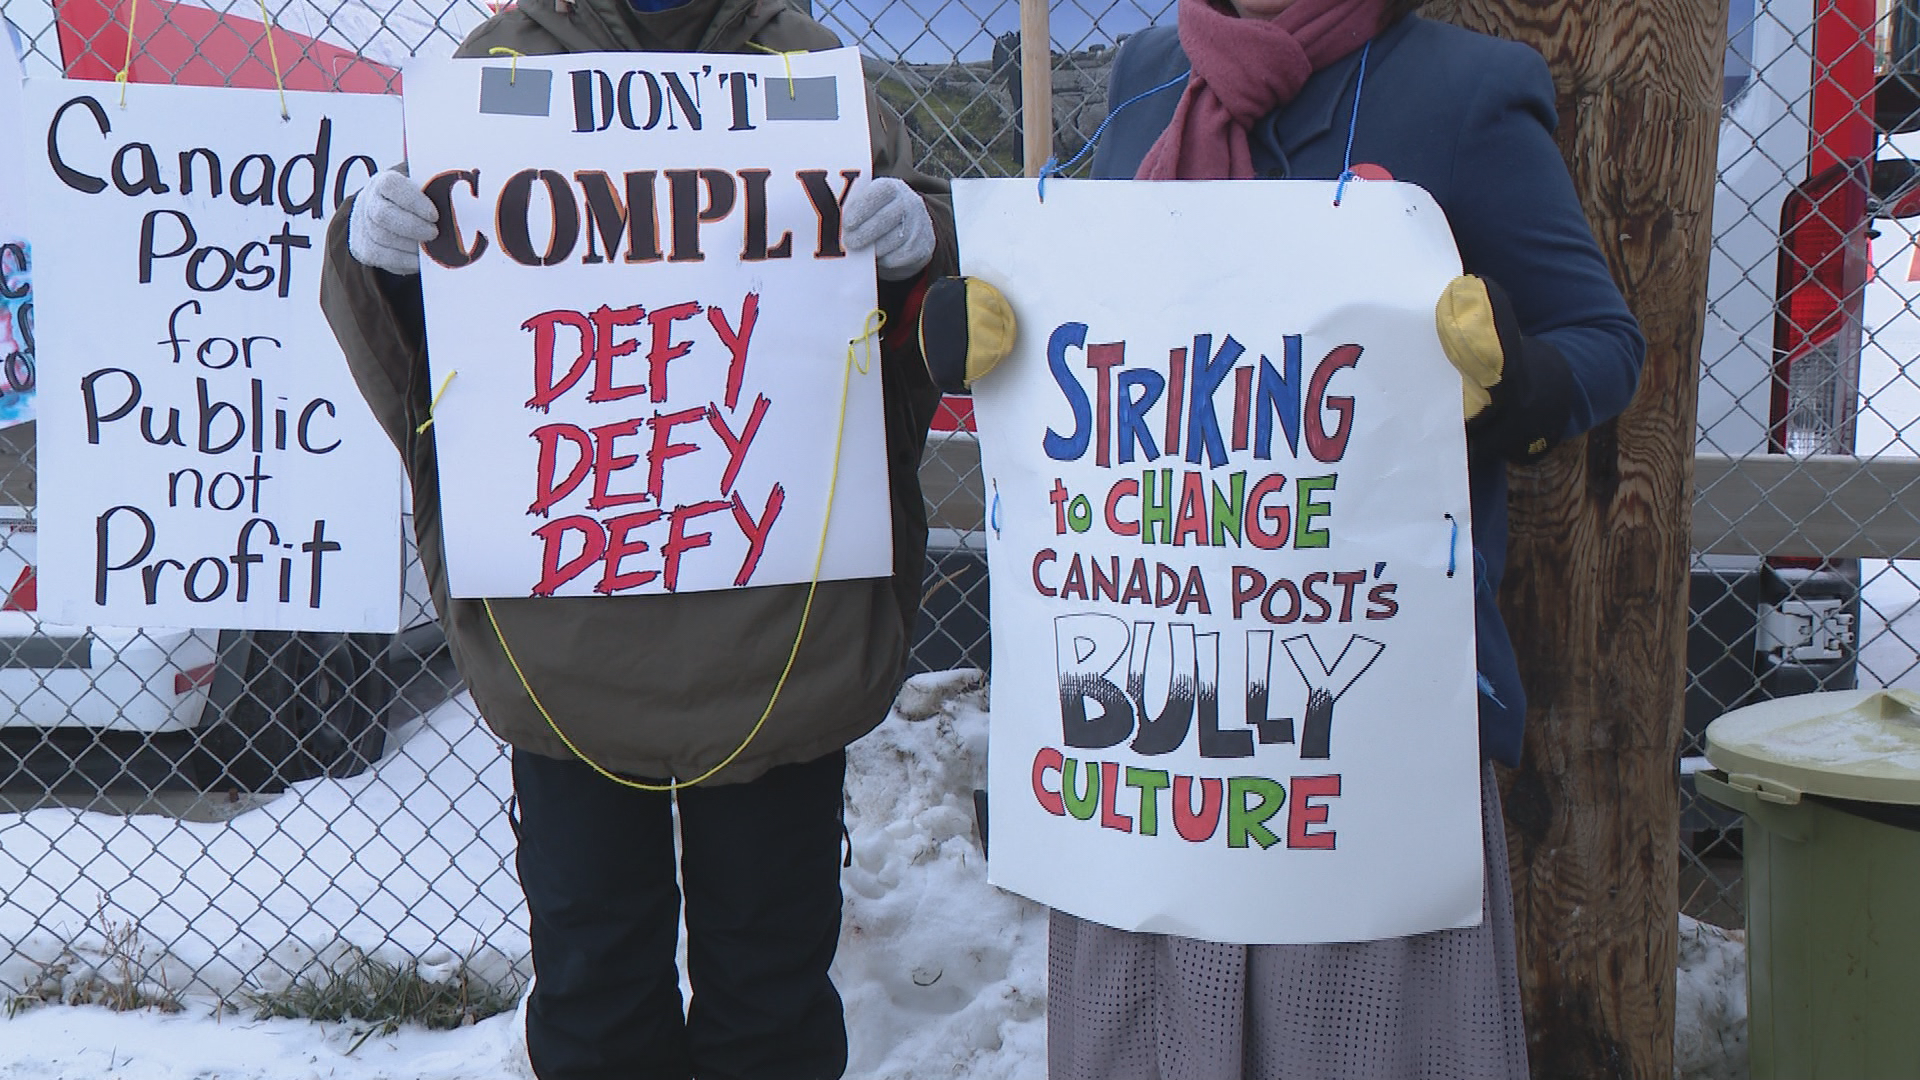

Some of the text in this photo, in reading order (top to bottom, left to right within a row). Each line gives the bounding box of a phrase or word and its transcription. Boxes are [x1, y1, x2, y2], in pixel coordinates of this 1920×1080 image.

[568, 65, 758, 133] DON'T
[139, 210, 312, 298] Post
[420, 168, 861, 268] COMPLY
[157, 299, 281, 370] for
[520, 291, 760, 414] DEFY
[81, 367, 342, 455] Public
[1043, 321, 1364, 470] STRIKING
[169, 455, 273, 513] not
[526, 392, 771, 518] DEFY
[95, 505, 341, 609] Profit
[529, 481, 785, 599] DEFY
[1049, 467, 1339, 550] to CHANGE
[1032, 547, 1211, 615] CANADA
[1053, 612, 1386, 760] BULLY
[1031, 746, 1341, 850] CULTURE
